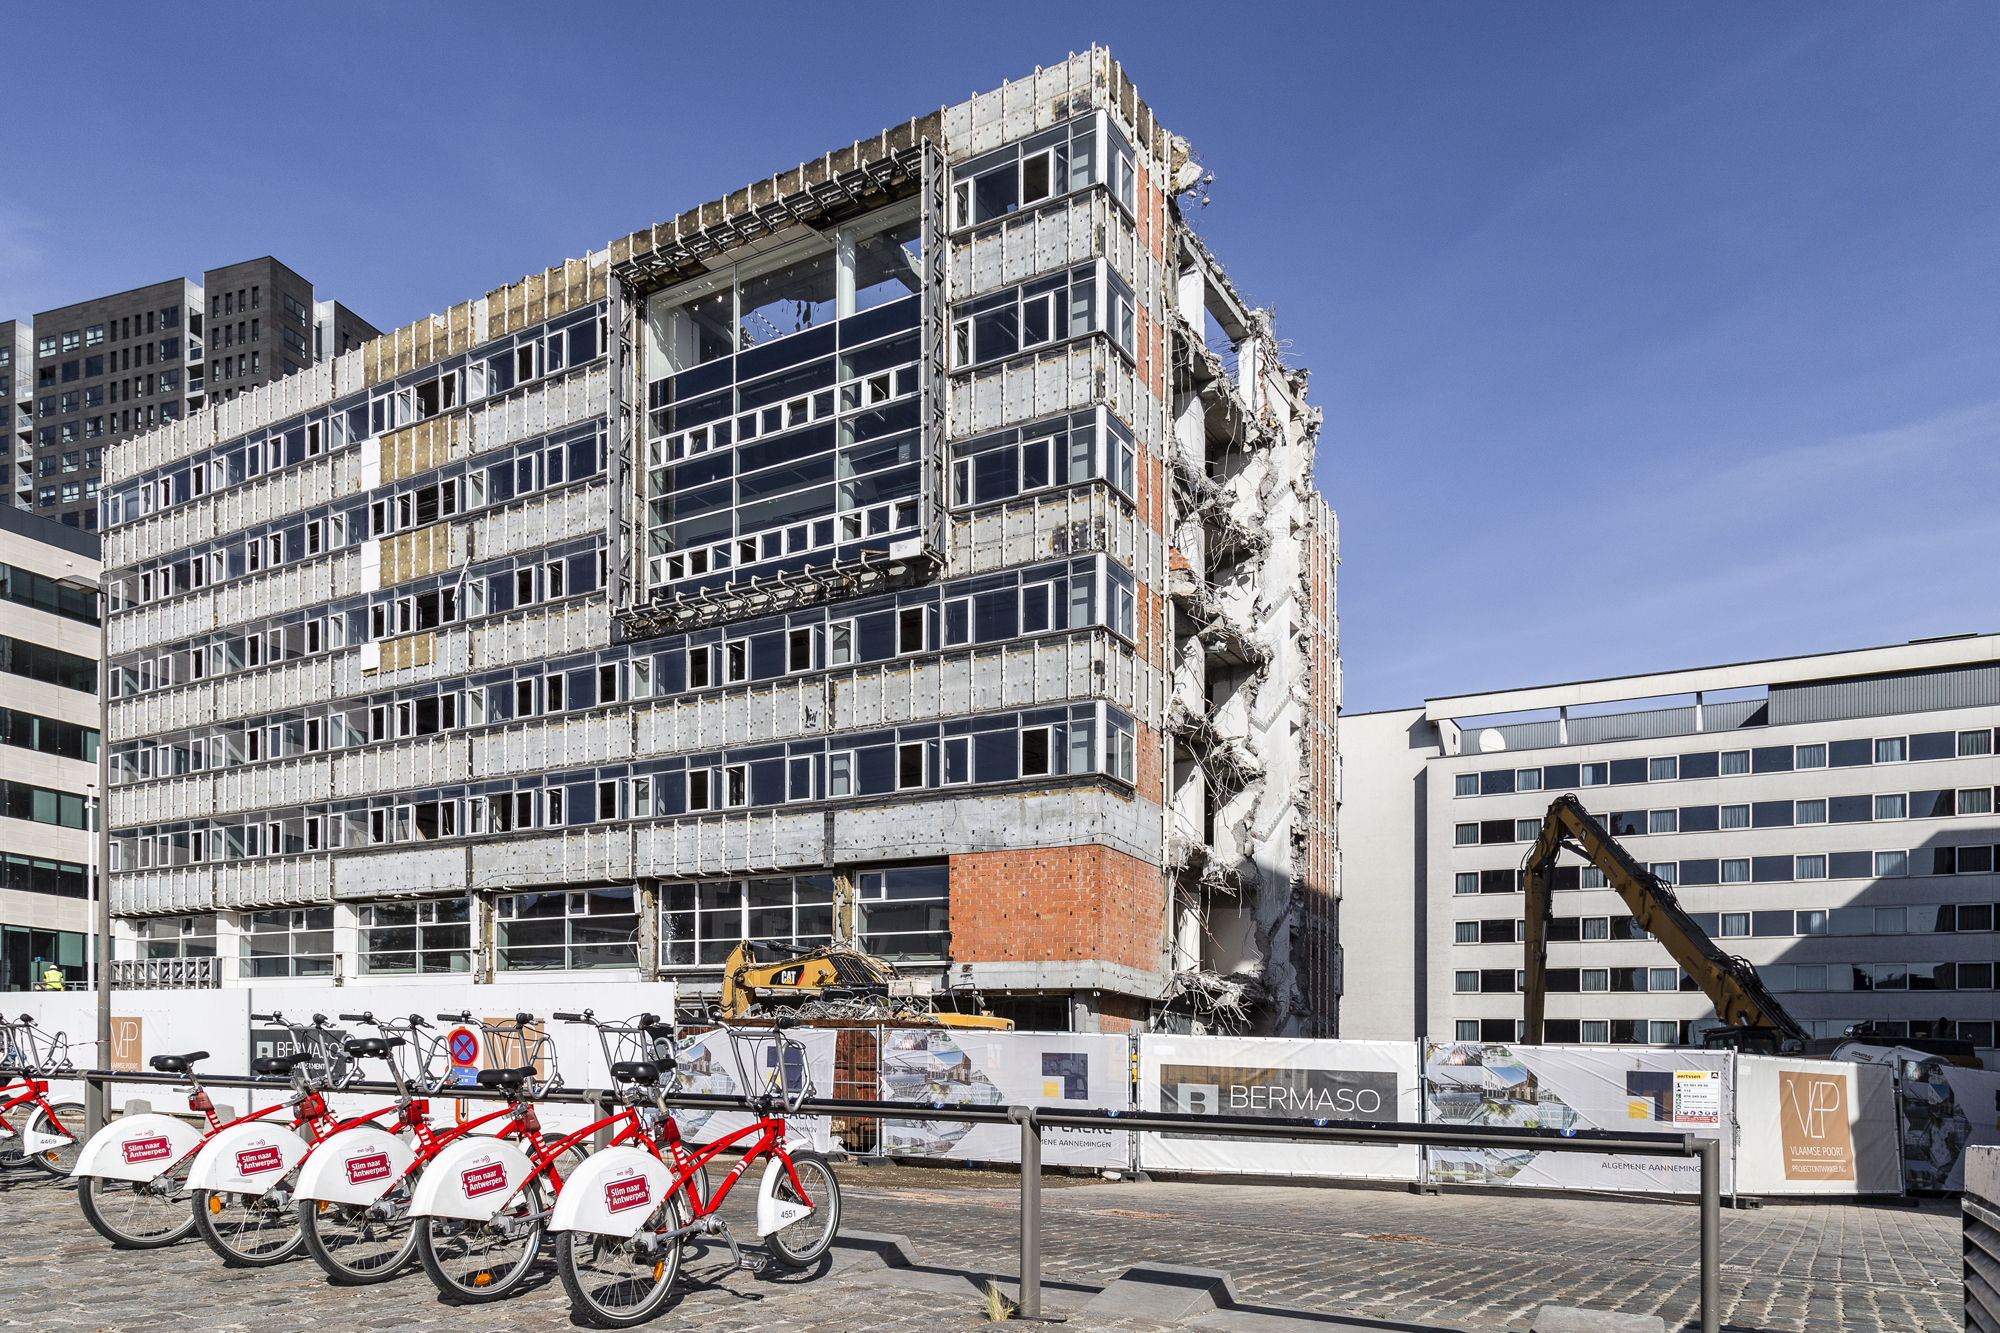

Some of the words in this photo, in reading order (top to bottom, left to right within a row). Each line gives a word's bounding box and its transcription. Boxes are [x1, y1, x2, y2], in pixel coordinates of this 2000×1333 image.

[781, 970, 796, 984] CAT
[1851, 1050, 1875, 1060] GENERAC
[1230, 1084, 1381, 1113] BERMASO
[128, 1144, 143, 1152] Slim
[144, 1142, 160, 1150] naar
[1058, 1139, 1112, 1148] AANNEMINGEN
[129, 1147, 167, 1158] Antwerpen
[1790, 1146, 1821, 1156] VLAAMSE
[1822, 1146, 1844, 1156] POORT
[242, 1154, 256, 1163] Slim
[257, 1152, 272, 1160] naar
[243, 1158, 279, 1170] Antwerpen
[351, 1162, 366, 1171] Slim
[367, 1159, 381, 1168] naar
[1601, 1161, 1647, 1171] ALGEMENE
[1648, 1163, 1701, 1173] AANNEMING
[353, 1165, 387, 1178] Antwerpen
[467, 1174, 482, 1184] Slim
[482, 1170, 497, 1180] naar
[469, 1177, 503, 1191] Antwerpen
[610, 1187, 626, 1197] Slim
[626, 1183, 641, 1193] naar
[612, 1190, 646, 1206] Antwerpen
[780, 1209, 796, 1219] 4551
